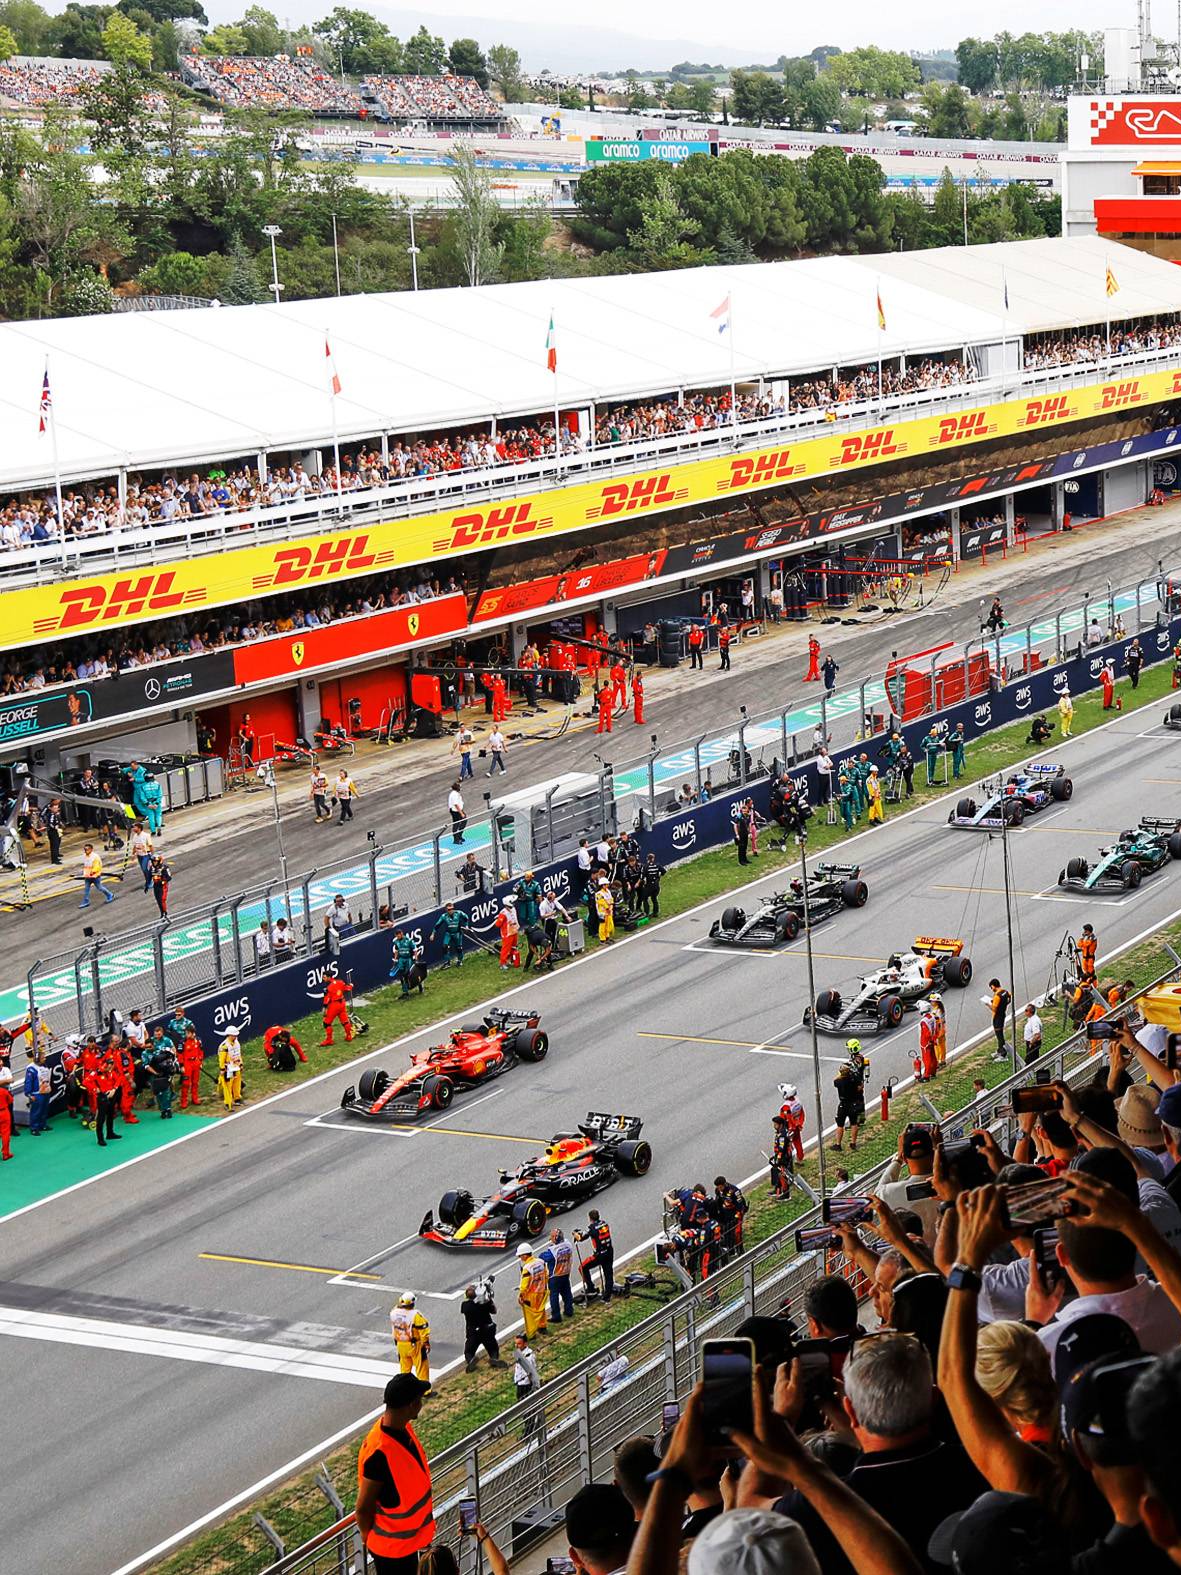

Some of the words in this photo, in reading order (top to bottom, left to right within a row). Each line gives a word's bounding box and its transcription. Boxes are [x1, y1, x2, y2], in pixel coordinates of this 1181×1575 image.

[658, 130, 682, 141] QATAR
[602, 144, 640, 158] aramco
[650, 144, 688, 158] aramco
[1102, 382, 1142, 408] DHL
[1026, 396, 1070, 425] DHL
[939, 412, 988, 443] DHL
[840, 430, 898, 464] DHL
[730, 450, 794, 488] DHL
[601, 475, 675, 516] DHL
[450, 503, 538, 548] DHL
[273, 535, 376, 585] DHL
[576, 576, 592, 590] 16
[59, 571, 185, 628] DHL
[1156, 630, 1170, 646] aws
[1090, 656, 1104, 672] aws
[1053, 670, 1068, 686] aws
[1016, 686, 1032, 702] aws
[0, 706, 38, 725] EORGE
[974, 702, 992, 719] aws
[0, 718, 40, 738] USSELL
[672, 820, 696, 840] aws
[543, 870, 570, 892] aws
[470, 898, 499, 920] aws
[306, 960, 340, 988] aws
[214, 996, 250, 1026] aws
[559, 1166, 600, 1190] ORACLE
